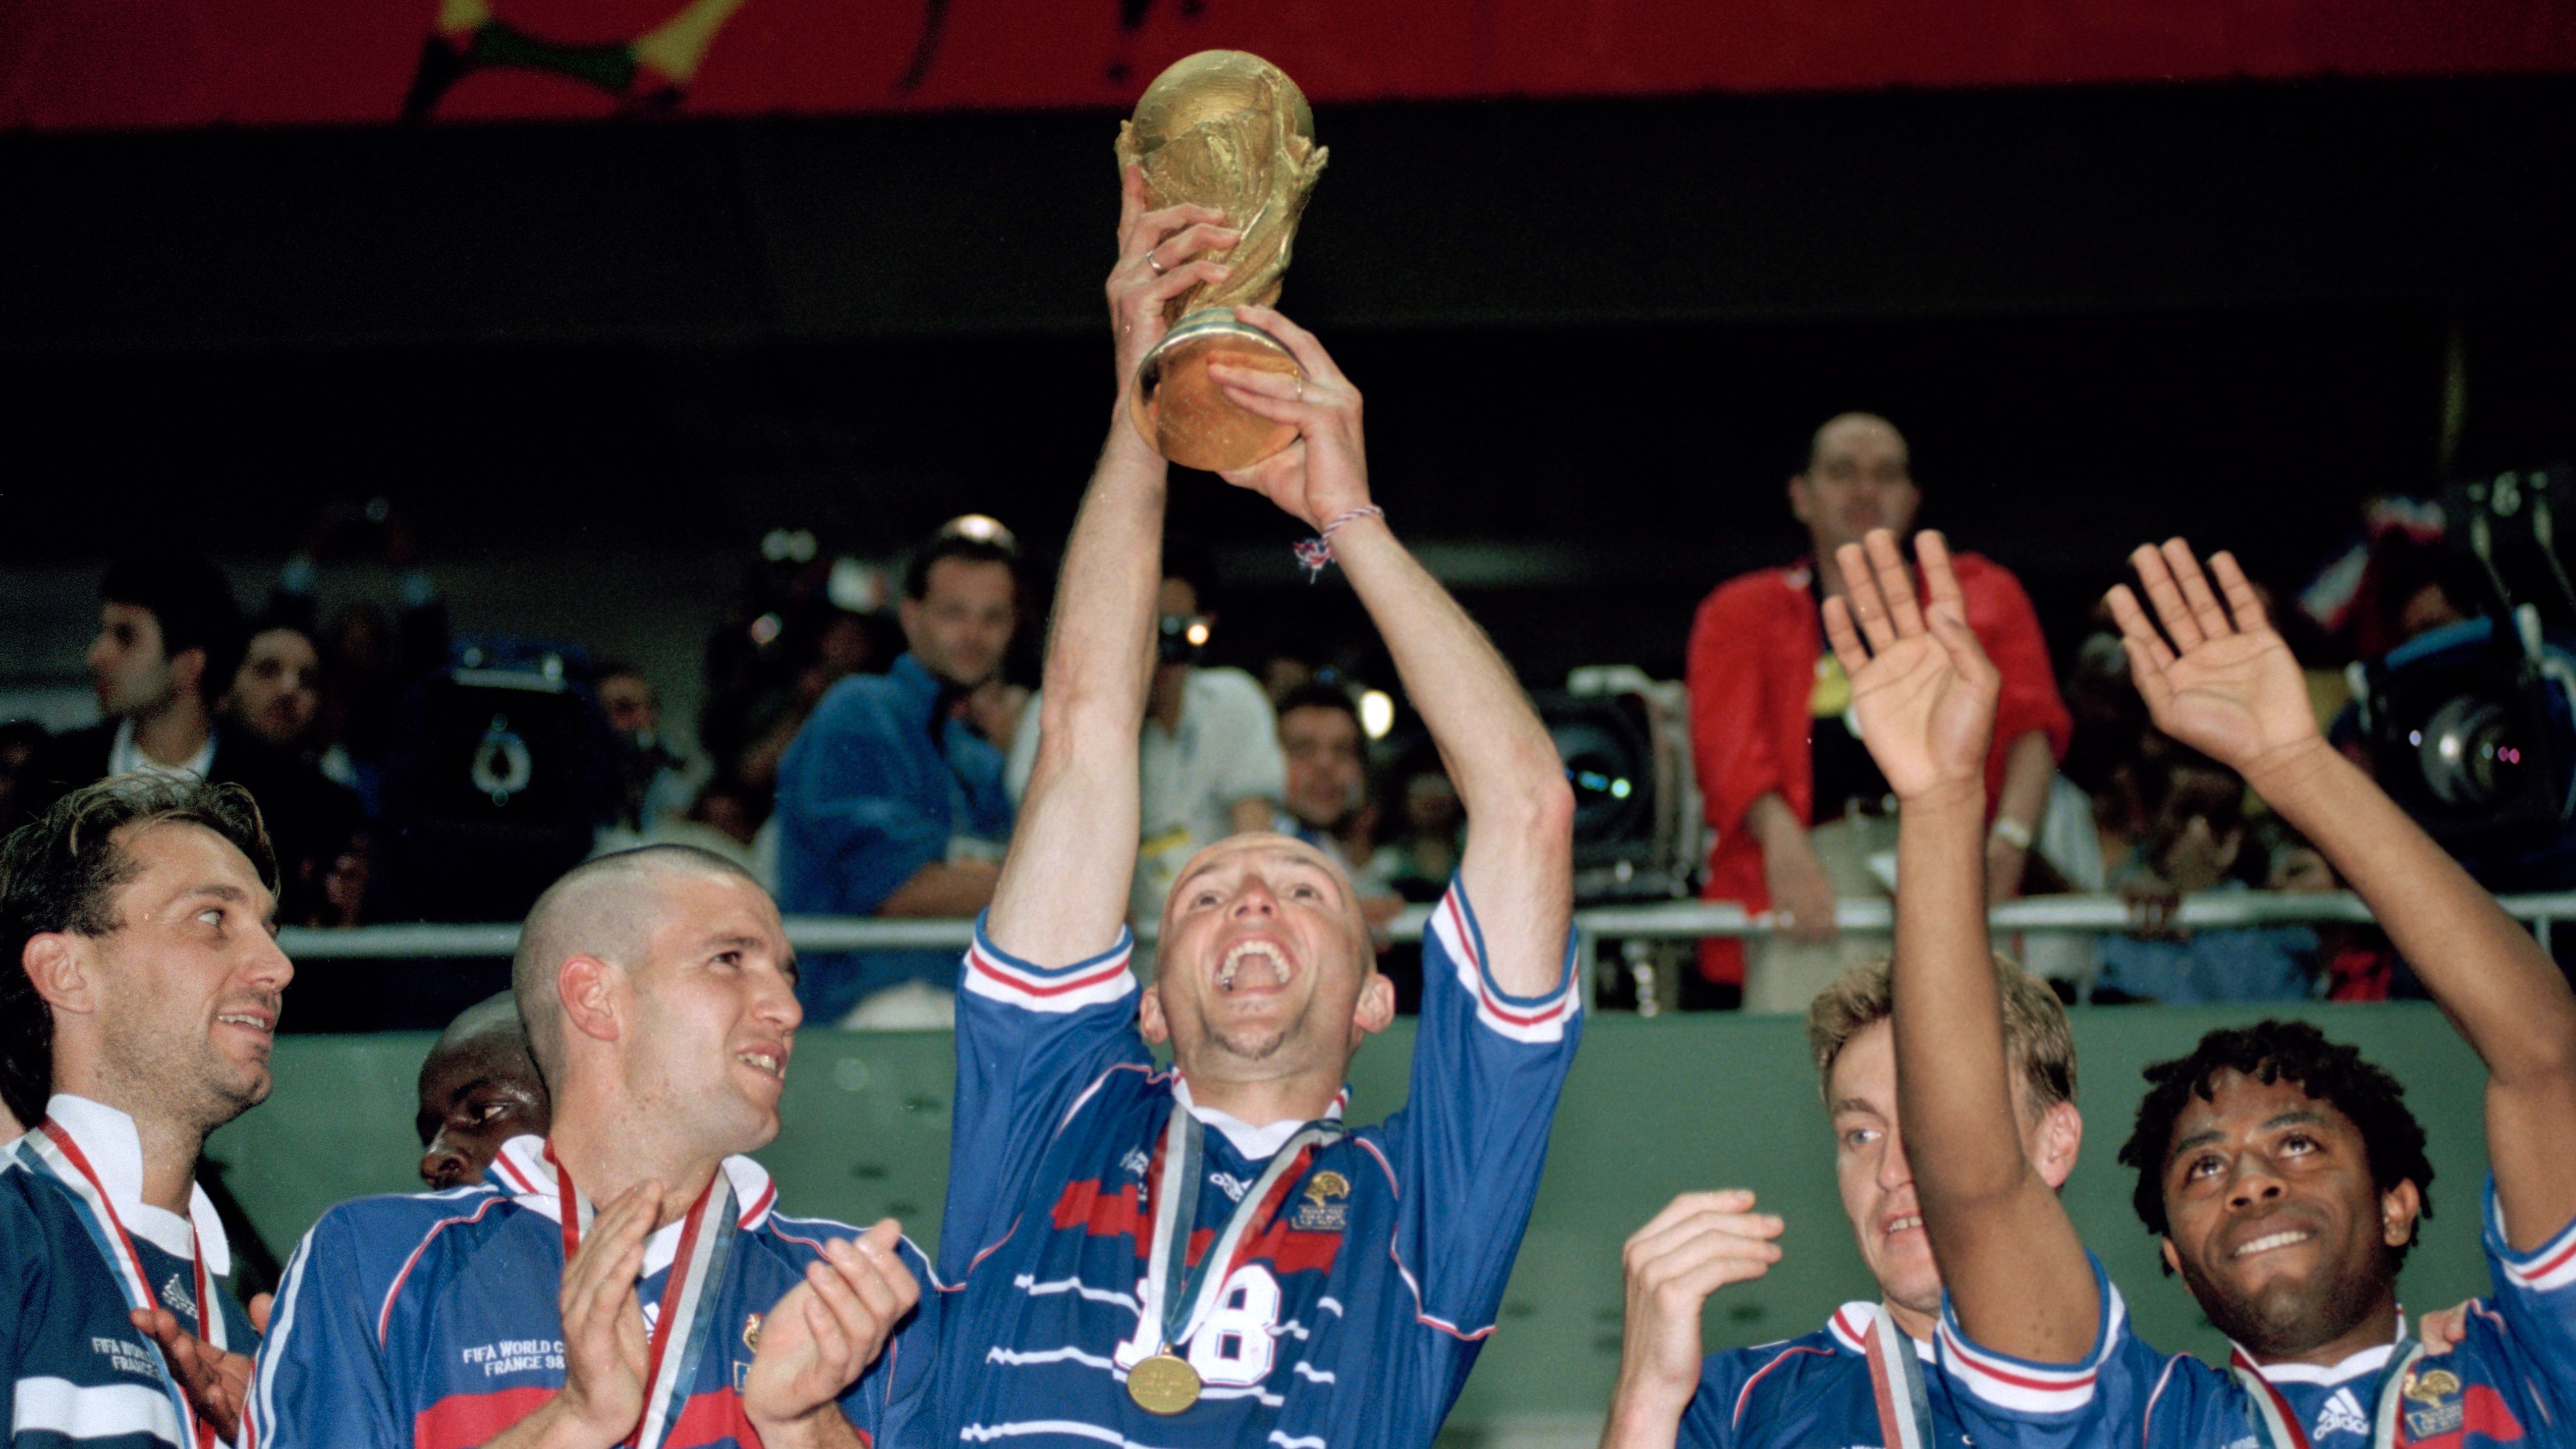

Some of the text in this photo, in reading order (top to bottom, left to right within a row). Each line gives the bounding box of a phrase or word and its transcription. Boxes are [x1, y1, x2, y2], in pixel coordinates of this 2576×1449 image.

[92, 1337, 120, 1354] FIFA
[463, 1345, 496, 1364] FIFA
[499, 1340, 550, 1357] WORLD
[485, 1355, 565, 1377] FRANCE 98
